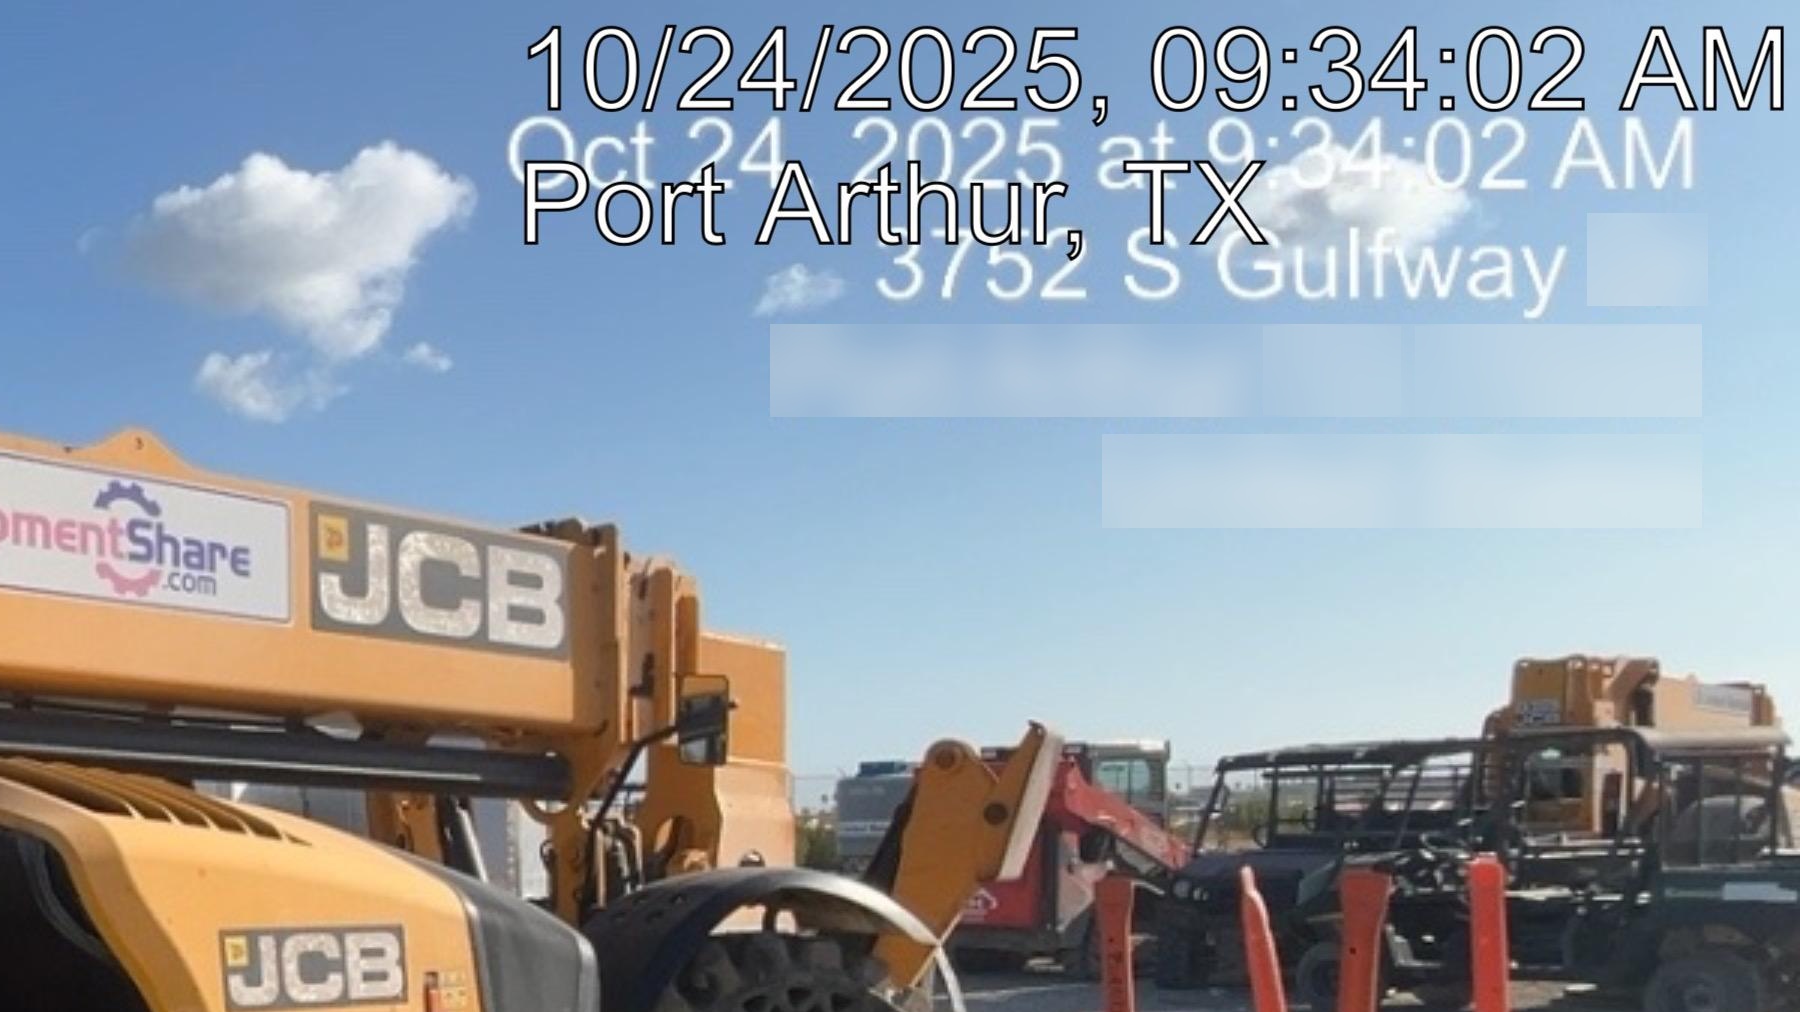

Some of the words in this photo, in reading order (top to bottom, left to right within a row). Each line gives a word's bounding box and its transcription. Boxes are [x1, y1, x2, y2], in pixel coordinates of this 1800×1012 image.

[162, 572, 217, 597] .com
[319, 523, 565, 649] JCB
[227, 931, 403, 1006] JCB
